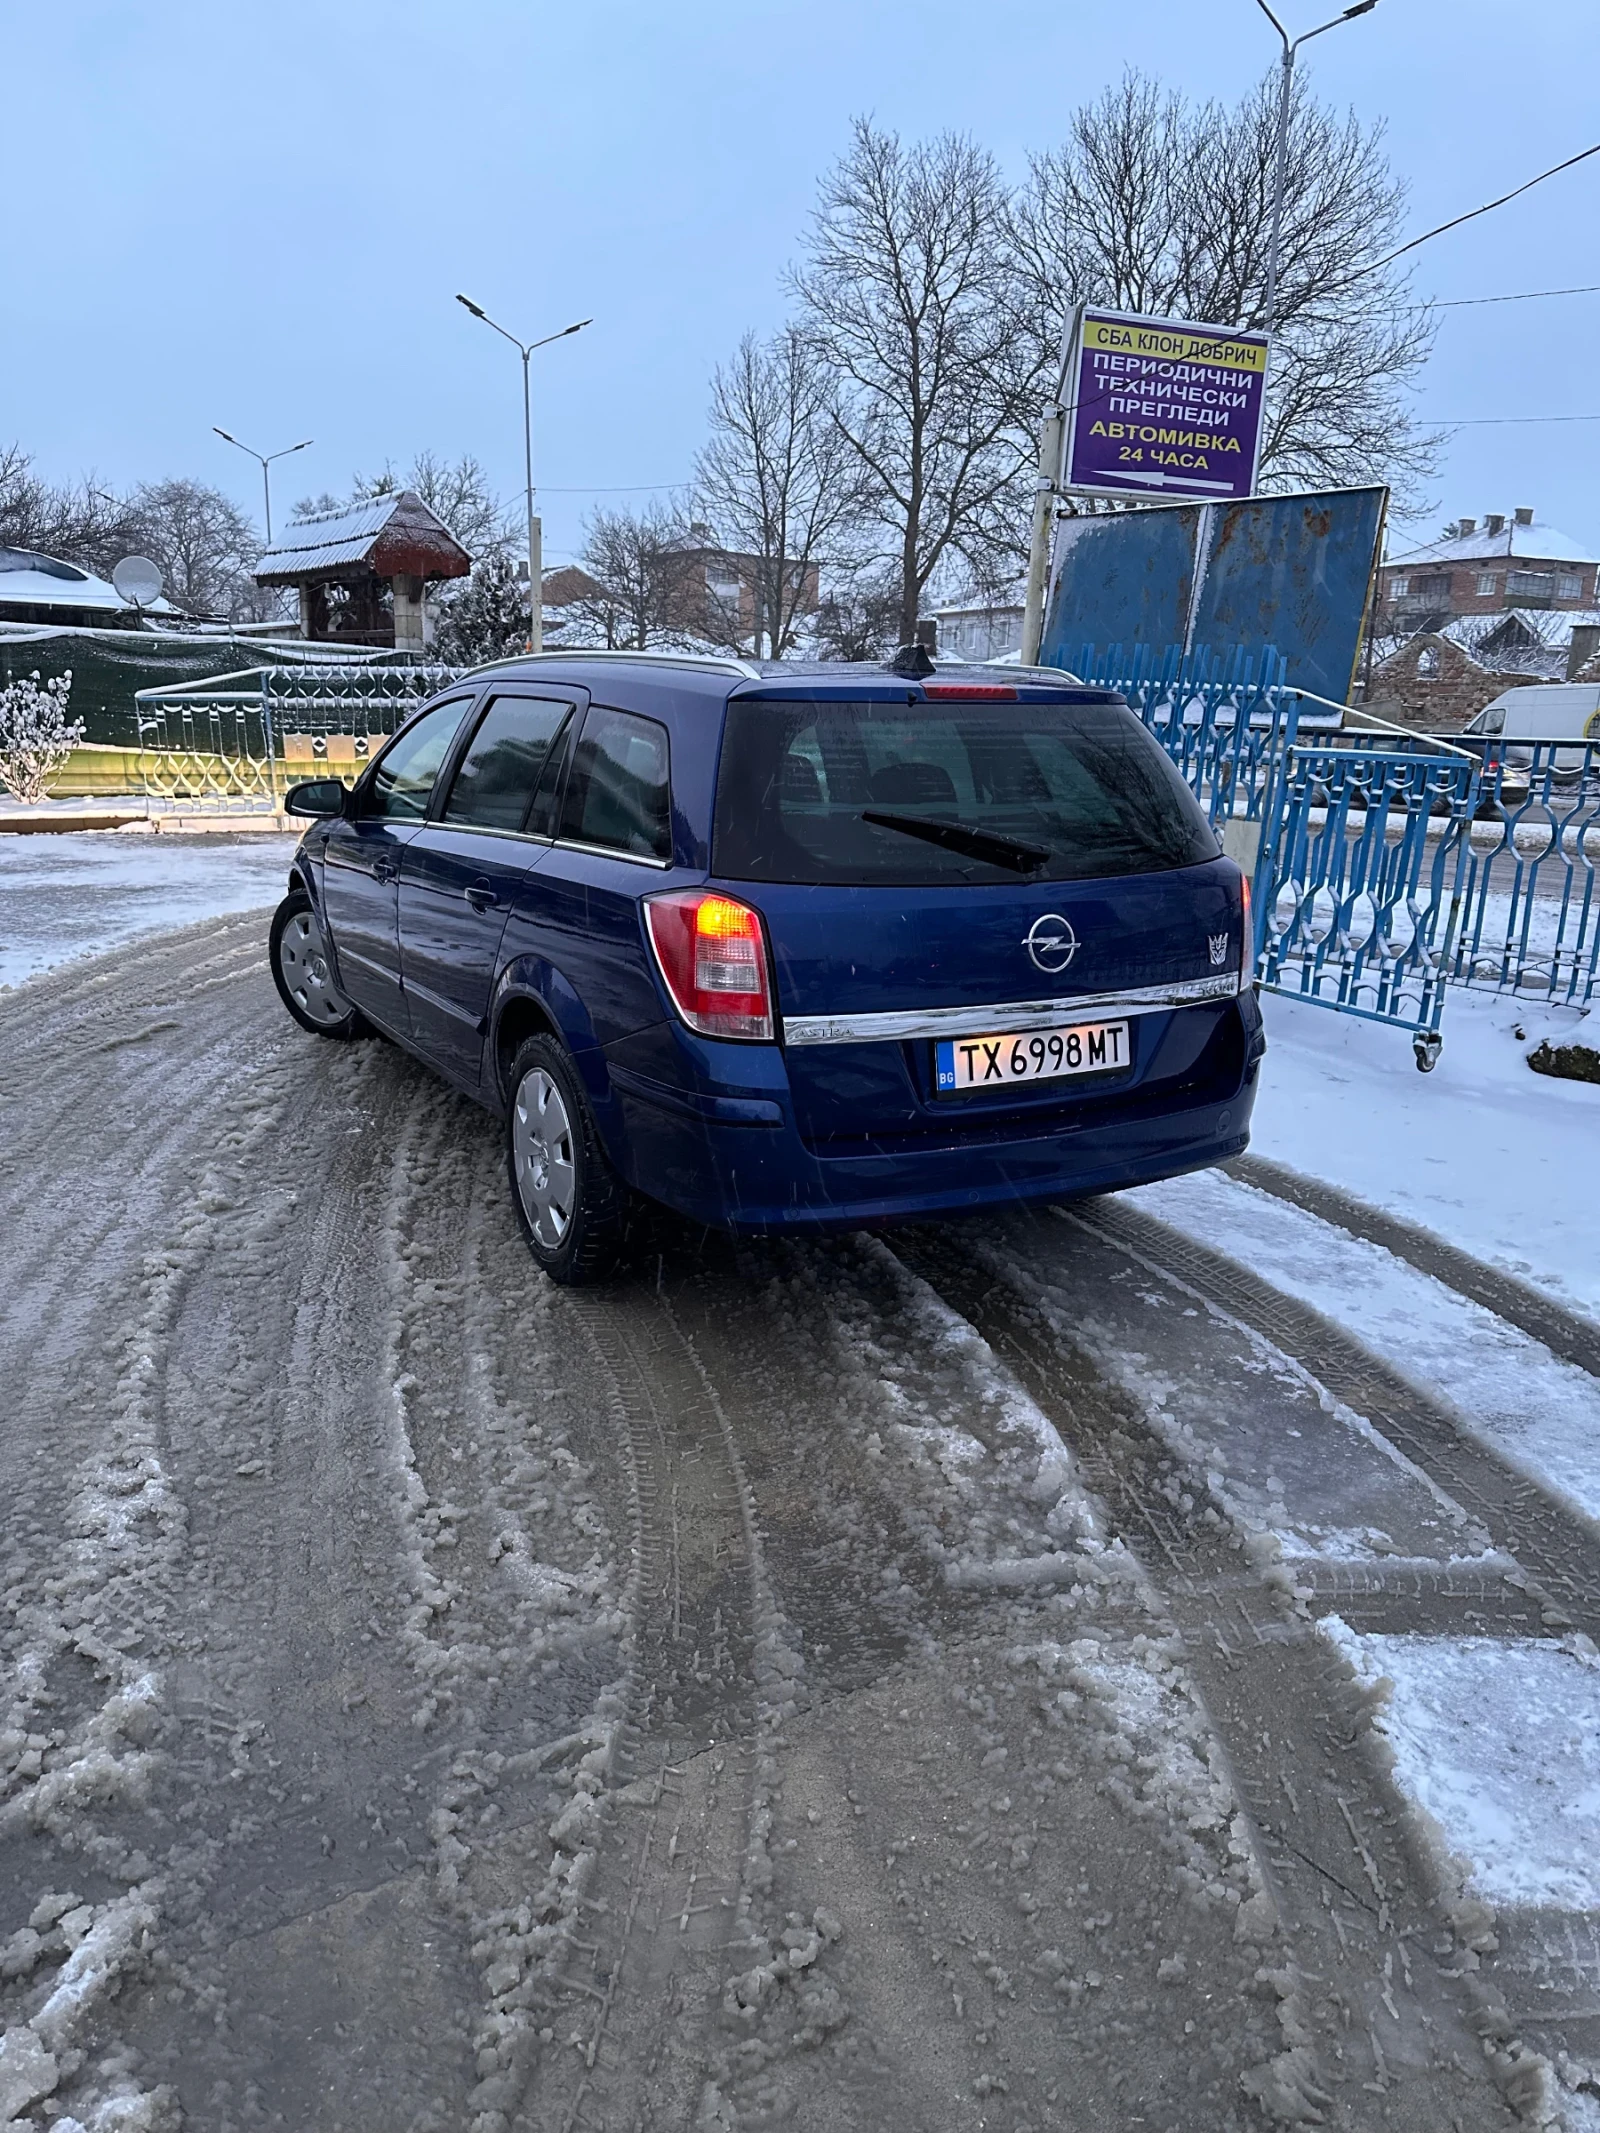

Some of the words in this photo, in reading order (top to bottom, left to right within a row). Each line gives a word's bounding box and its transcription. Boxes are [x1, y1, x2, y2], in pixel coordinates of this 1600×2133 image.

[1097, 327, 1133, 348] СБА
[1137, 333, 1184, 355] КЛОН
[1187, 341, 1257, 366] ДОБРИЧ
[1093, 353, 1253, 389] ПЕРИОДИЧНИ
[1095, 374, 1247, 409] ТЕХНИЧЕСКИ
[1109, 397, 1230, 427] ПРЕГЛЕДИ
[1089, 420, 1242, 453] АВТОМИВКА
[1118, 446, 1144, 462] 24
[1150, 450, 1209, 470] ЧАСА
[795, 1026, 855, 1038] ASTRA
[1010, 1033, 1083, 1076] 6998
[939, 1072, 954, 1084] BG
